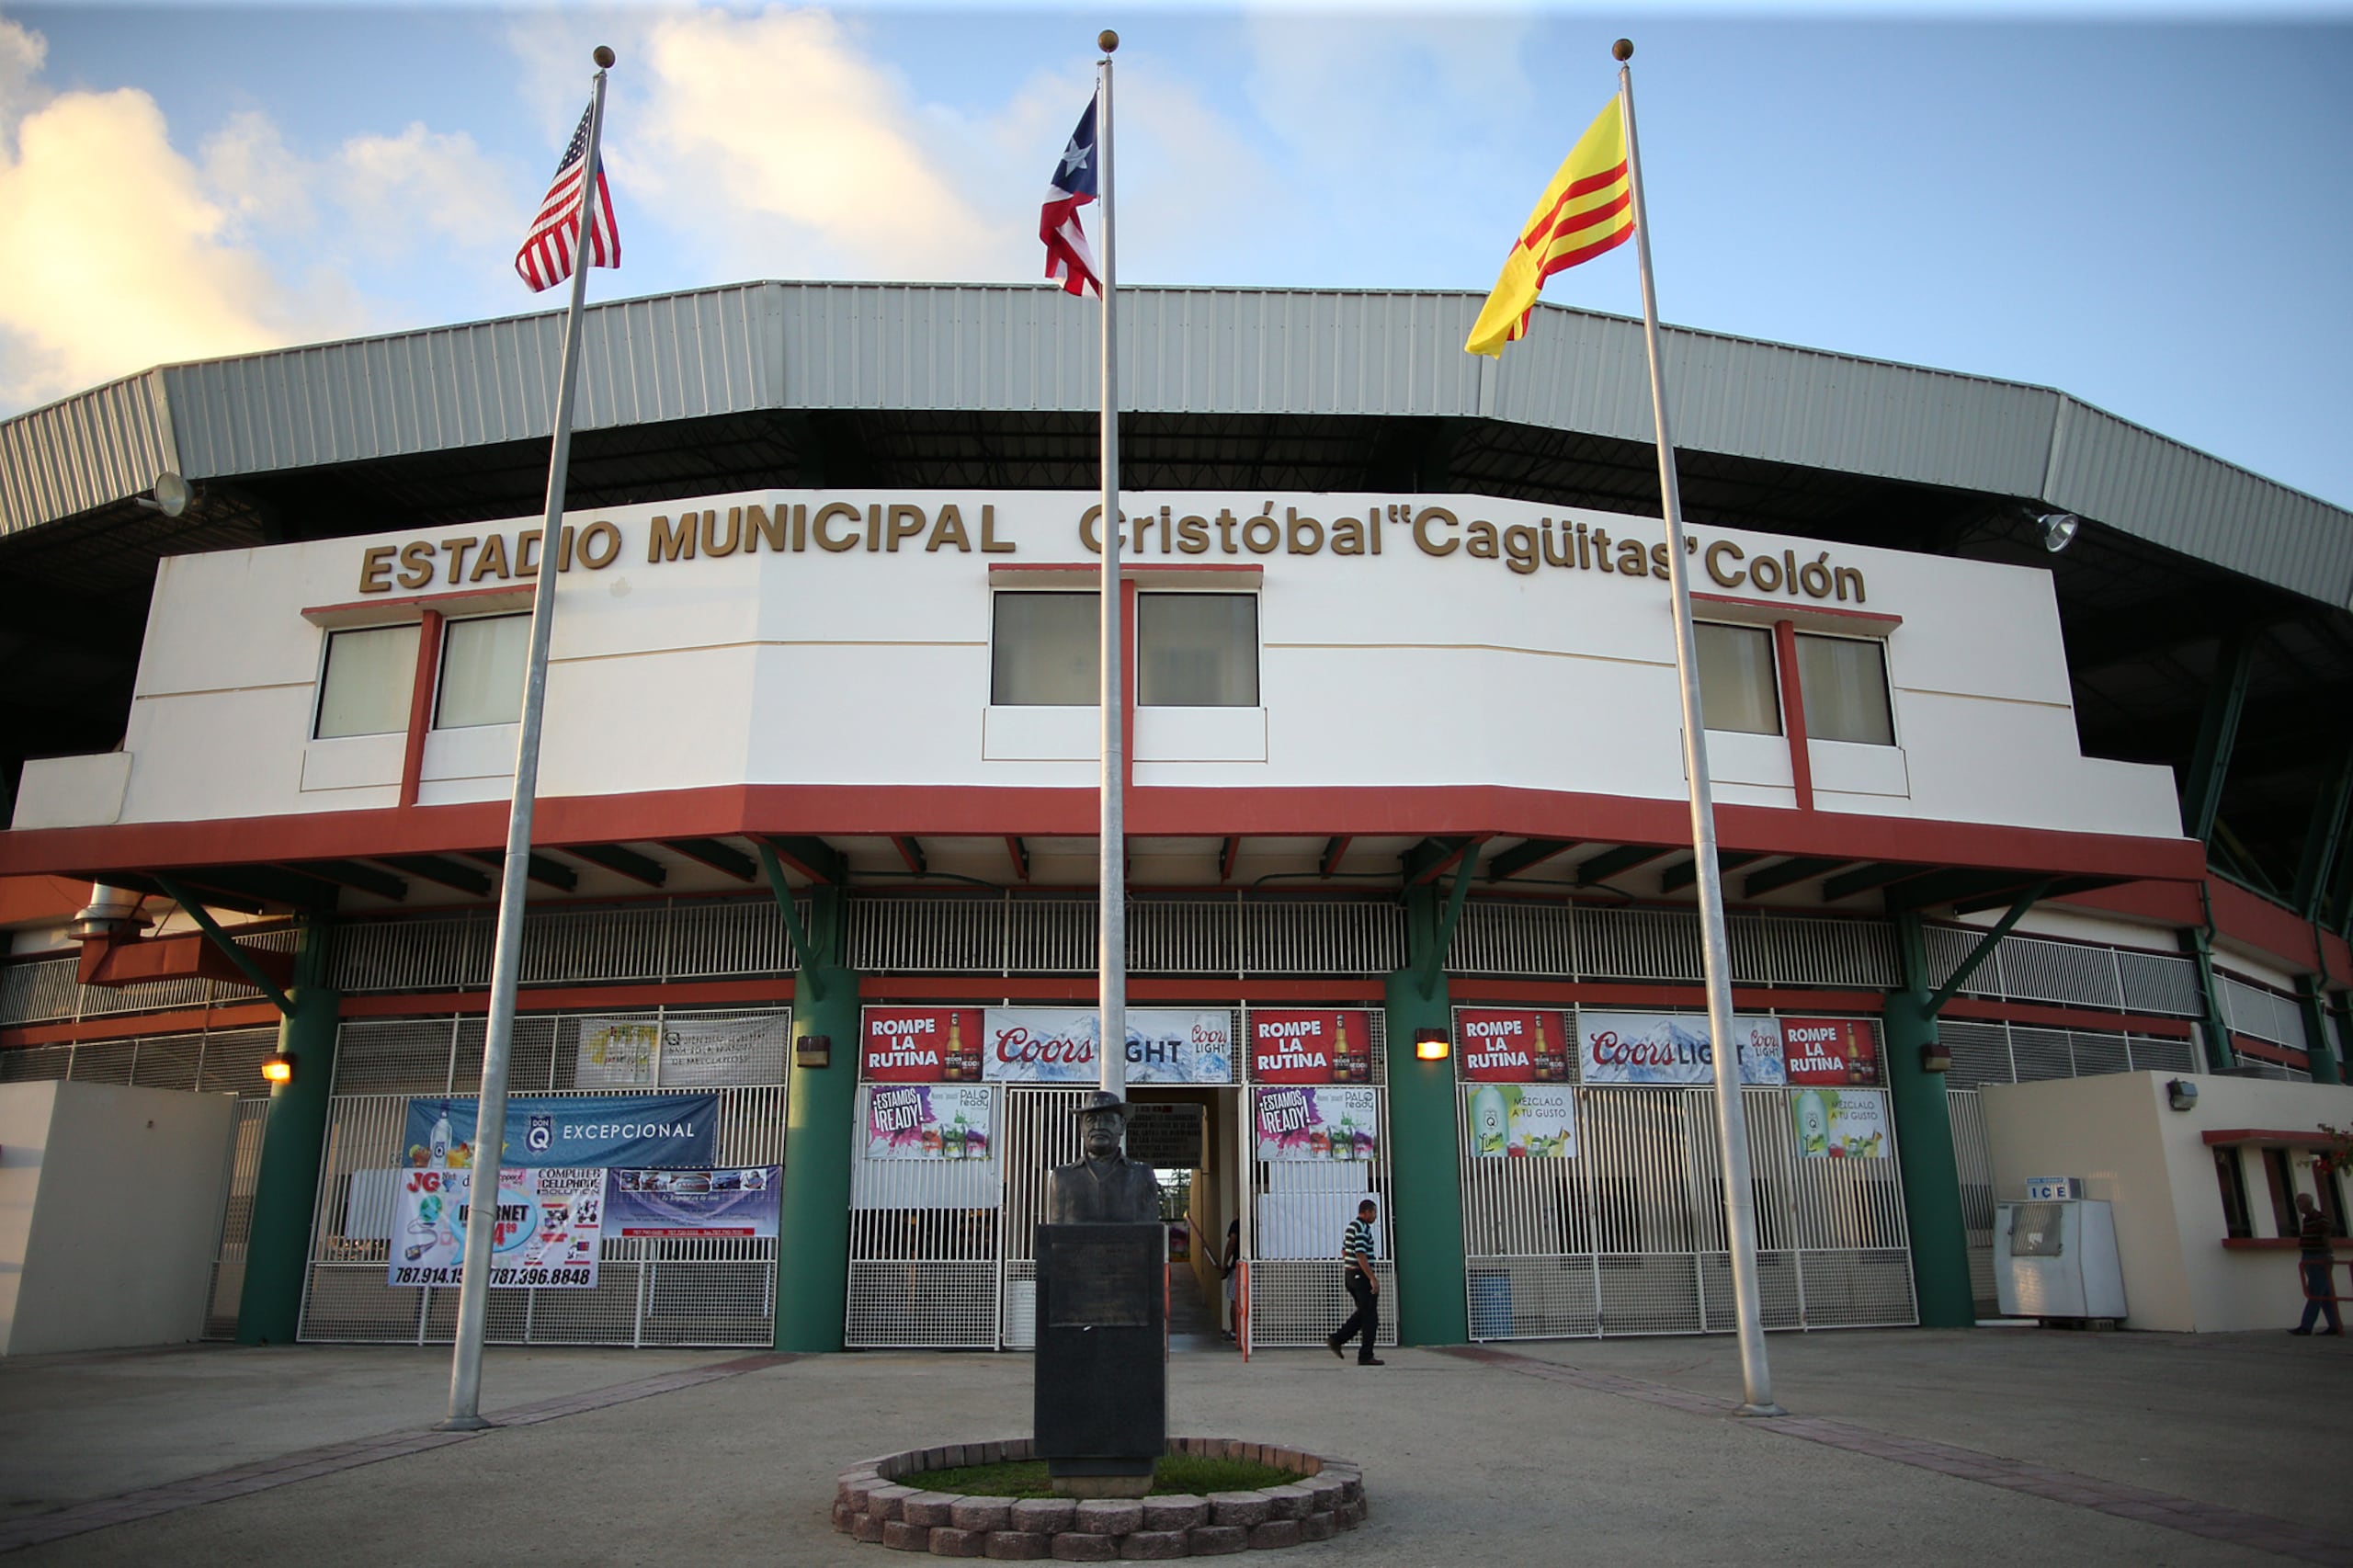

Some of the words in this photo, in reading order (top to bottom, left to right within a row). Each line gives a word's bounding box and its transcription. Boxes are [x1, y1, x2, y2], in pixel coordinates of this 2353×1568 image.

[359, 520, 622, 594] ESTADIO
[647, 502, 1017, 562] MUNICIPAL
[1079, 501, 1382, 556] Cristóbal
[1706, 540, 1866, 603] Colón
[871, 1017, 936, 1036] ROMPE
[1257, 1020, 1322, 1039] ROMPE
[1465, 1020, 1523, 1038] ROMPE
[1787, 1027, 1836, 1042] ROMPE
[891, 1035, 916, 1051] LA
[995, 1027, 1095, 1063] Coors
[1098, 1040, 1183, 1062] GHT
[1196, 1043, 1225, 1053] LIGHT
[1279, 1038, 1303, 1053] LA
[1484, 1037, 1508, 1051] LA
[1590, 1030, 1676, 1066] Coors
[1677, 1043, 1745, 1065] LIGT
[1804, 1041, 1824, 1056] LA
[869, 1051, 939, 1068] RUTINA
[1756, 1047, 1779, 1057] LIGHT
[1256, 1052, 1327, 1070] RUTINA
[1467, 1051, 1529, 1069] RUTINA
[1790, 1057, 1845, 1073] RUTINA
[960, 1089, 989, 1100] PALO
[1345, 1091, 1373, 1101] PALO
[960, 1099, 989, 1110] ready
[1345, 1101, 1374, 1112] ready
[879, 1096, 924, 1132] READY!
[1265, 1097, 1311, 1133] READY!
[1512, 1108, 1519, 1117] A
[1522, 1108, 1532, 1118] TU
[1535, 1108, 1566, 1118] GUSTO
[1830, 1111, 1837, 1119] A
[1839, 1111, 1848, 1119] TU
[1850, 1111, 1878, 1120] GUSTO
[1486, 1117, 1495, 1126] Q
[1809, 1119, 1817, 1129] Q
[529, 1127, 549, 1149] Q
[563, 1122, 695, 1140] EXCEPCIONAL
[538, 1168, 601, 1179] COMPUTER
[407, 1172, 440, 1192] JG
[2032, 1187, 2066, 1199] ICE
